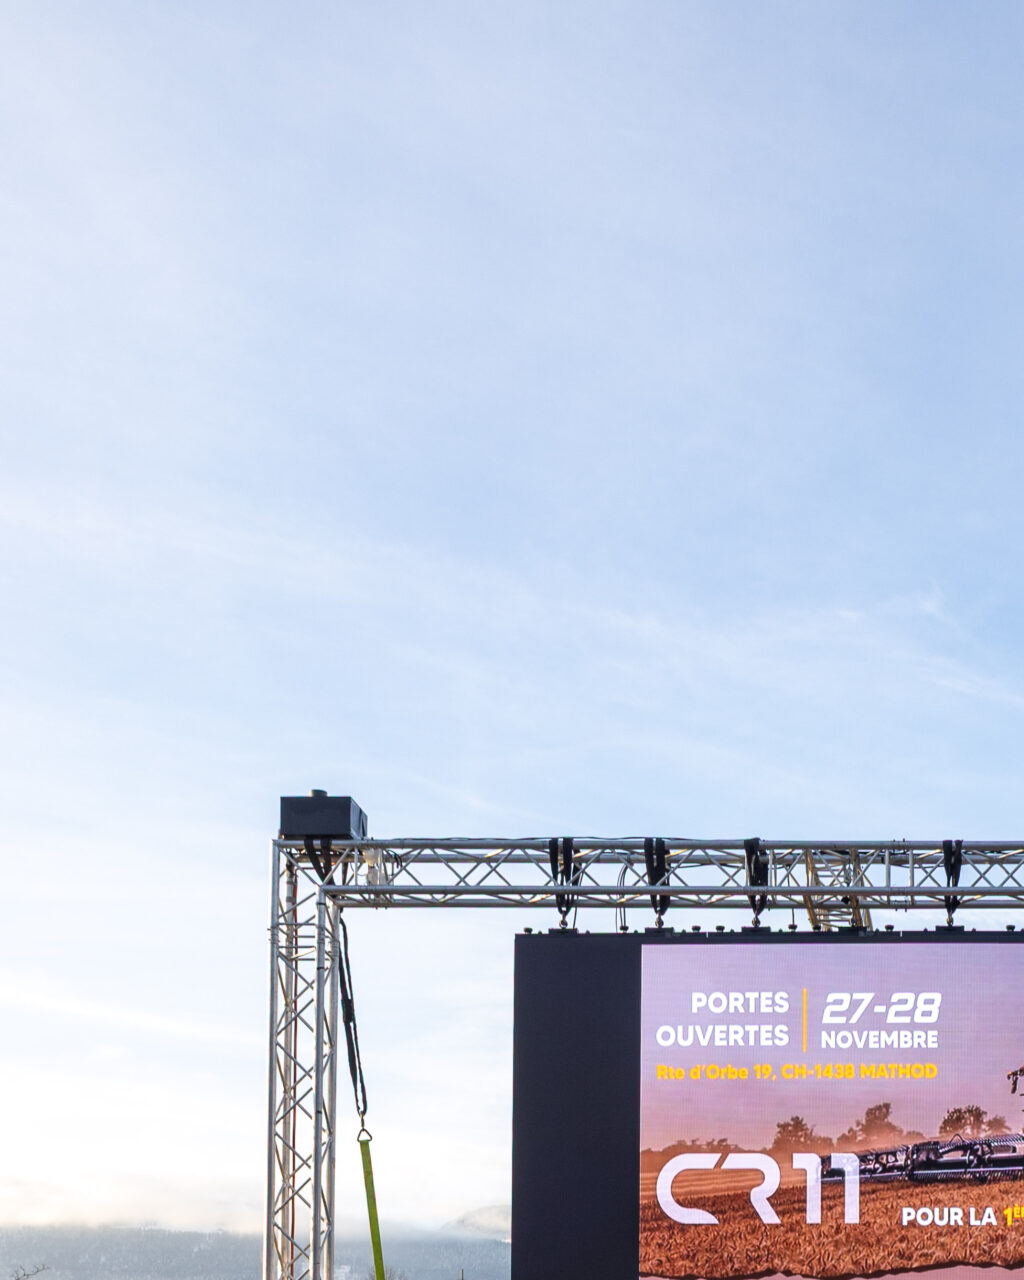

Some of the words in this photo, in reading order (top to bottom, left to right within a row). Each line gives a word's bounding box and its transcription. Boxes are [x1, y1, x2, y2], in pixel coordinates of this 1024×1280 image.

[692, 992, 789, 1013] PORTES
[822, 992, 942, 1024] 27-28
[656, 1025, 789, 1046] OUVERTES
[821, 1031, 938, 1049] NOVEMBRE
[656, 1064, 685, 1079] Rte
[689, 1064, 748, 1079] d'Orbe
[754, 1064, 776, 1080] 19,
[782, 1064, 855, 1079] CH-1438
[860, 1064, 938, 1079] MATHOD
[656, 1153, 860, 1225] CR11
[902, 1207, 963, 1226] POUR
[969, 1207, 997, 1226] LA
